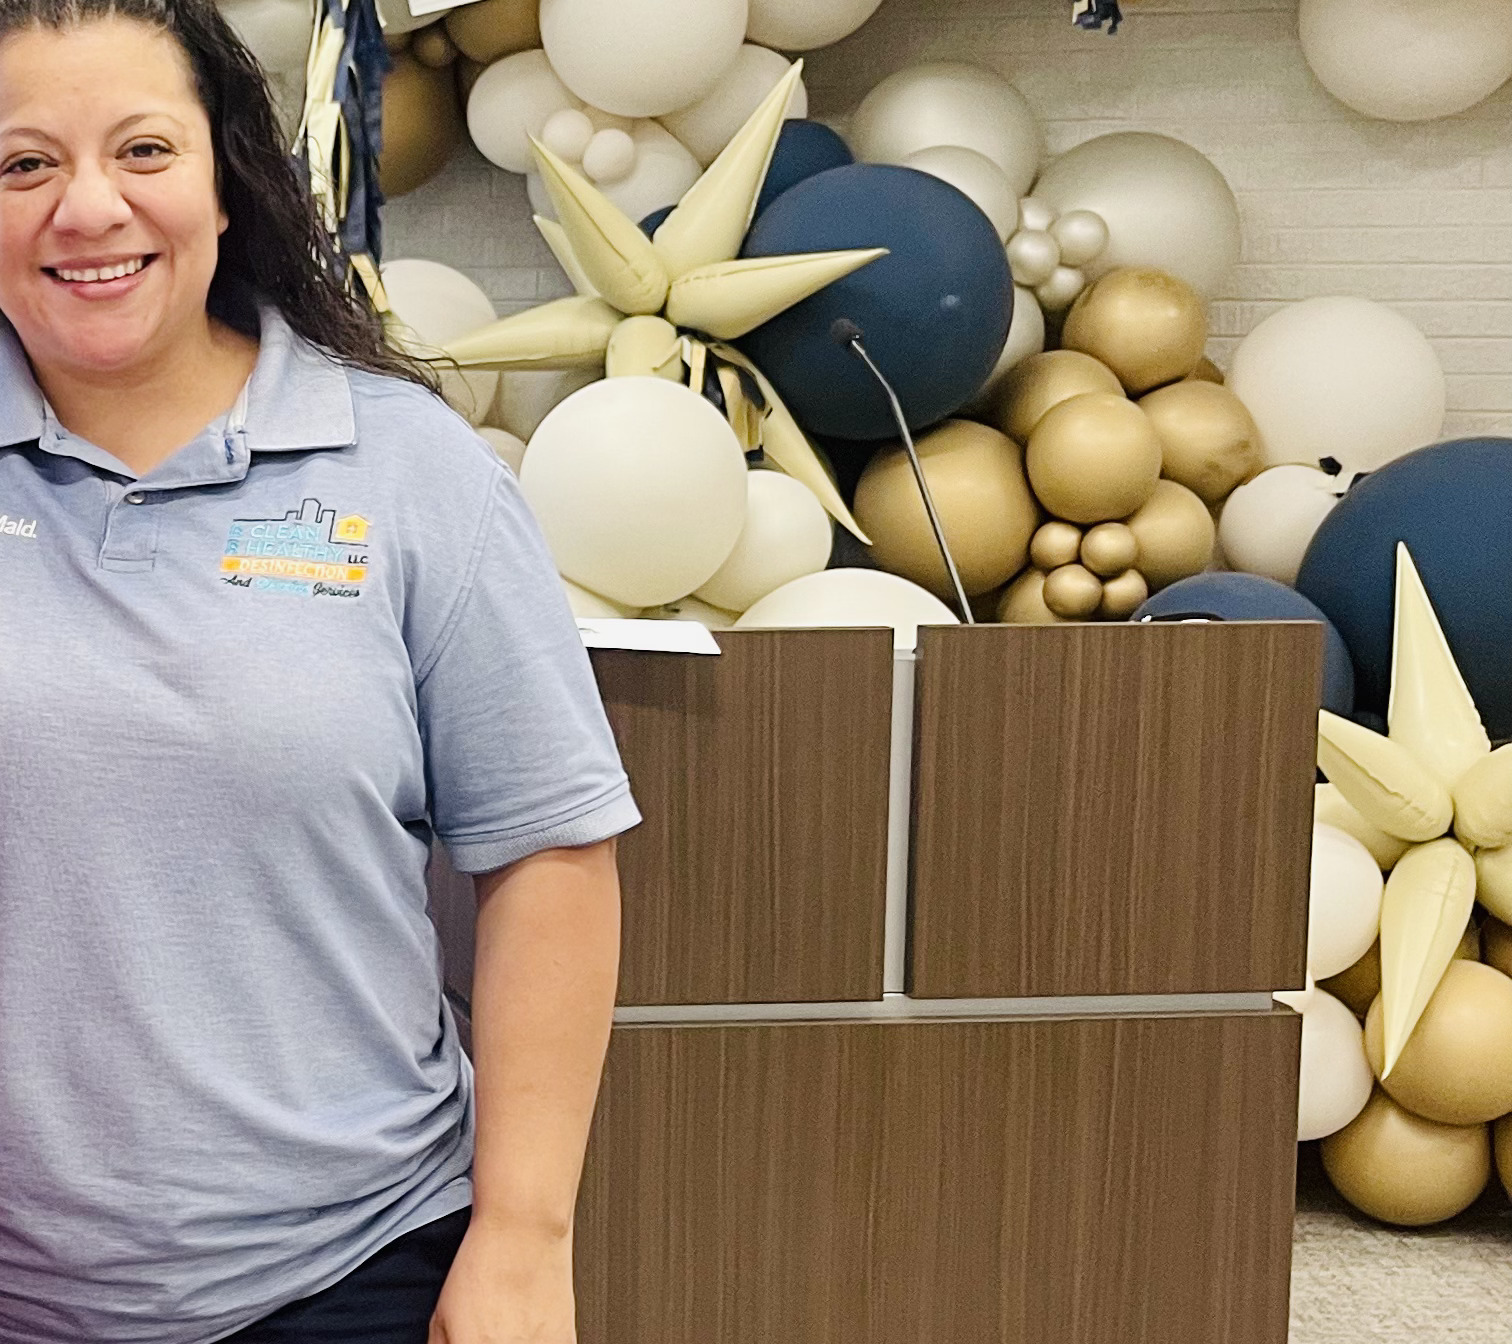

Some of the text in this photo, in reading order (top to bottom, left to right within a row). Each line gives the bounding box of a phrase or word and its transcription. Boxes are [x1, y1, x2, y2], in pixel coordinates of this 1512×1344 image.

[251, 523, 321, 541] CLEAN
[246, 540, 369, 565] HEALTHY LLC
[240, 558, 348, 581] DESINFECTION
